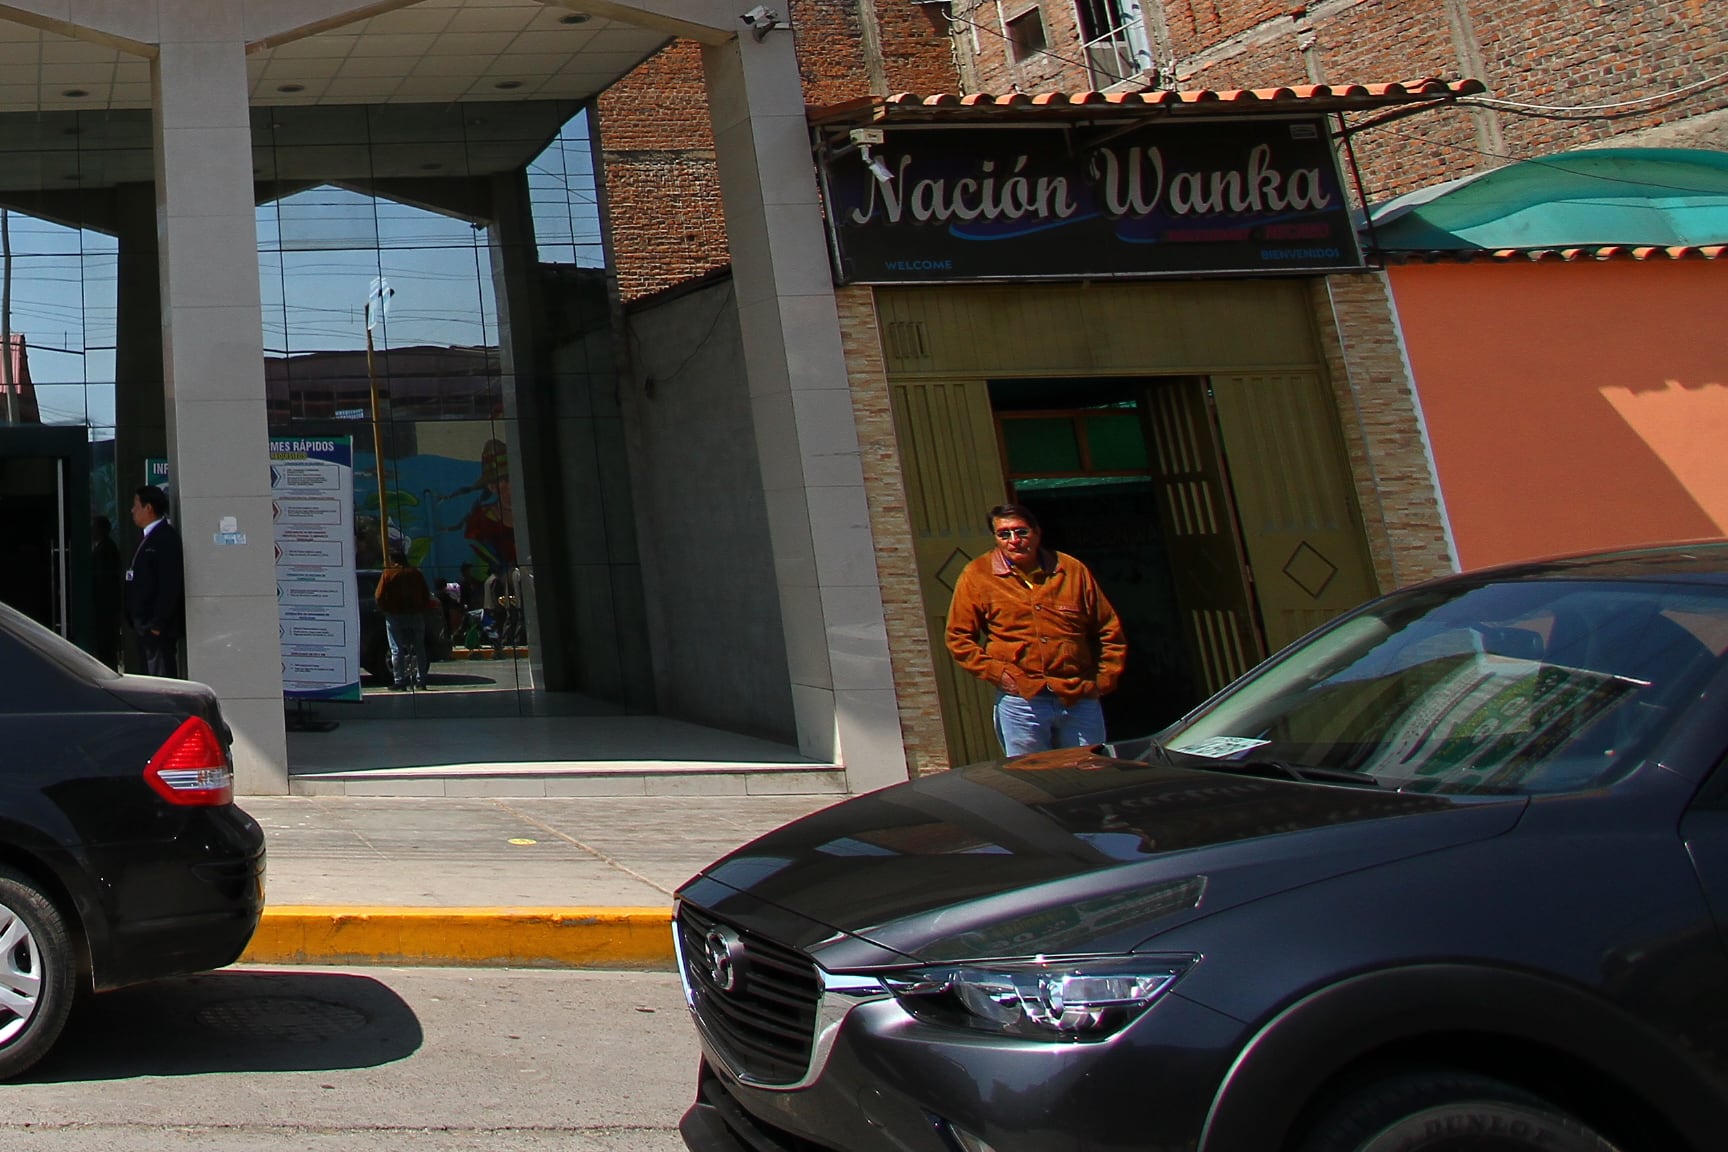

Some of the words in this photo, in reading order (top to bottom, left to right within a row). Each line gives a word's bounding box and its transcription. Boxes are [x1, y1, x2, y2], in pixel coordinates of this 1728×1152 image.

[851, 154, 1077, 226] Nación
[1092, 143, 1331, 218] Wanka
[885, 259, 952, 271] WELCOME
[293, 439, 335, 451] RÁPIDOS
